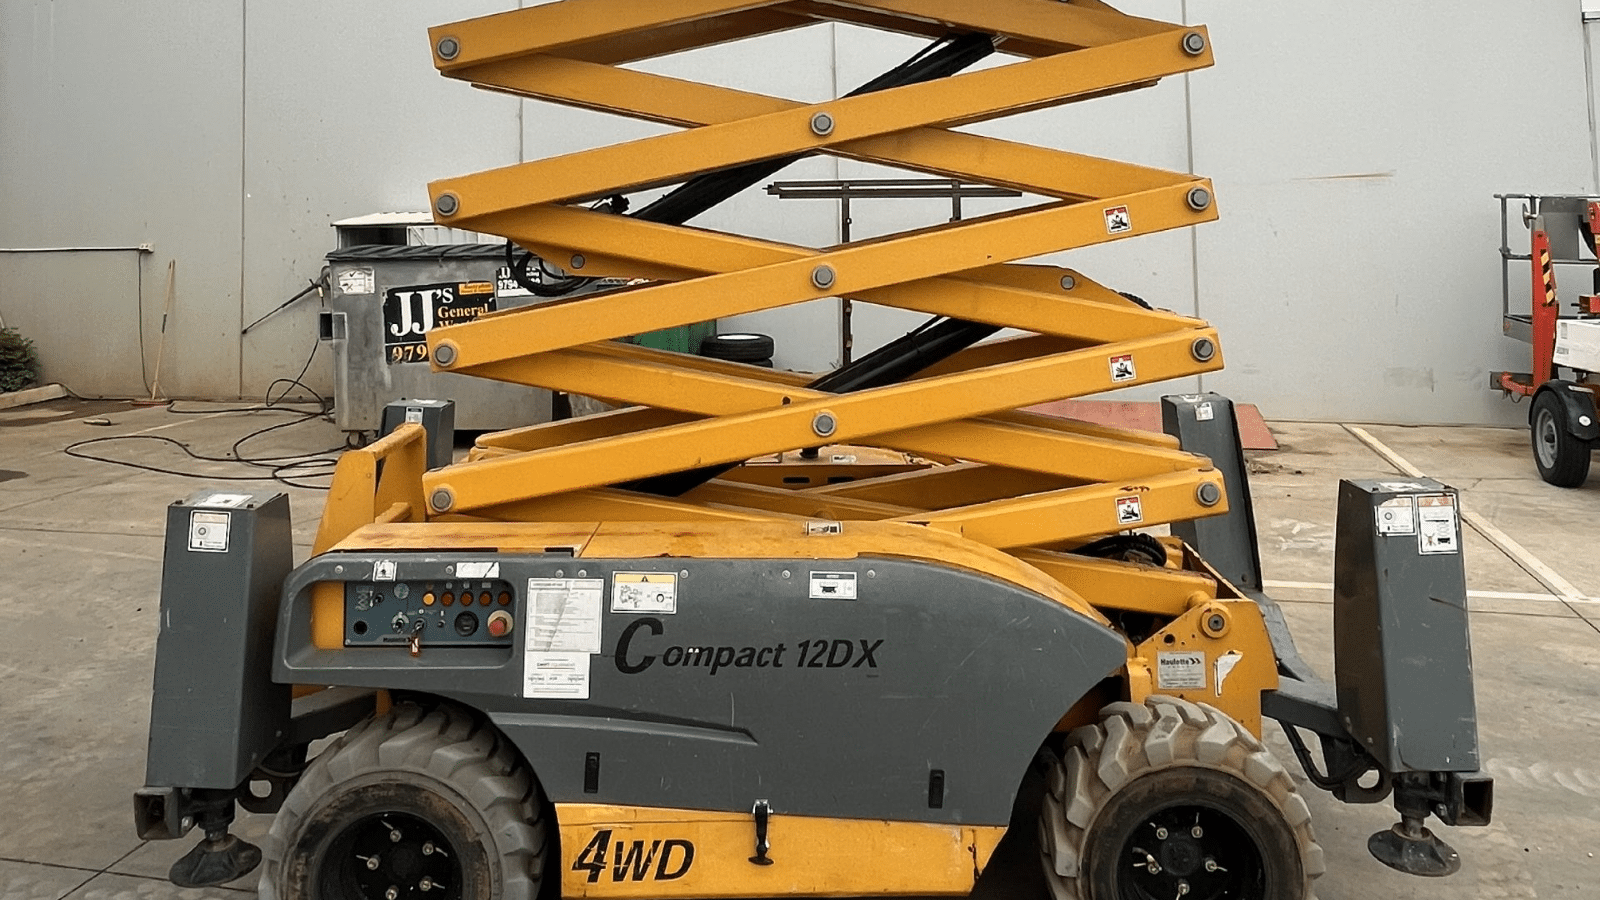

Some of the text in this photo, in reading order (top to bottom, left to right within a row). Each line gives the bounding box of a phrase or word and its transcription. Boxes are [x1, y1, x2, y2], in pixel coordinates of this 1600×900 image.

[390, 287, 454, 336] JJ's
[437, 303, 489, 318] General
[613, 617, 787, 676] Compact
[797, 639, 884, 668] 12DX
[571, 829, 695, 883] 4WD
